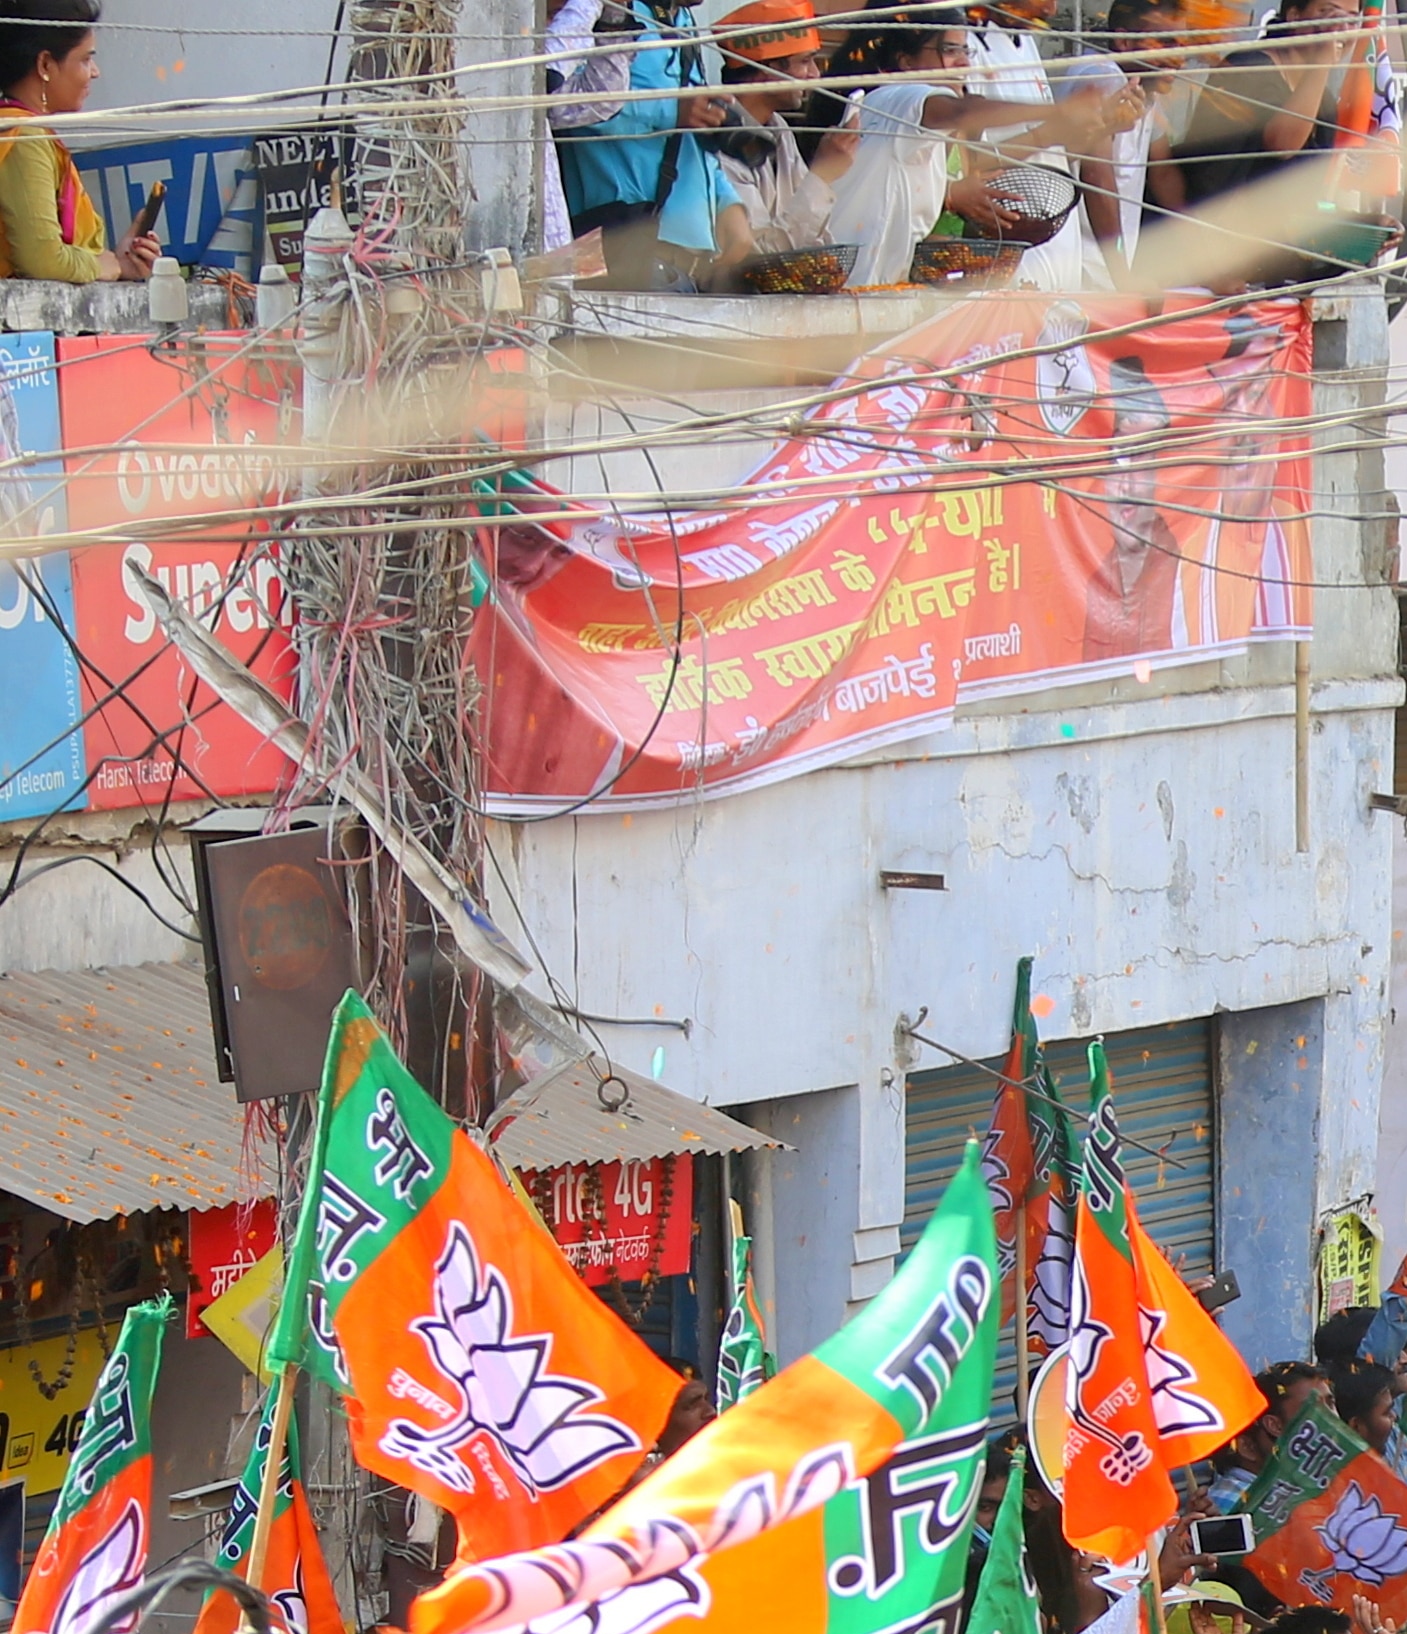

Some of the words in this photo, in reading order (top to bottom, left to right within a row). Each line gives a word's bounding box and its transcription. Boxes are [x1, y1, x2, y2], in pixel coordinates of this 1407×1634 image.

[829, 549, 876, 593] के
[15, 767, 65, 796] Telecom
[613, 1158, 653, 1217] 4G
